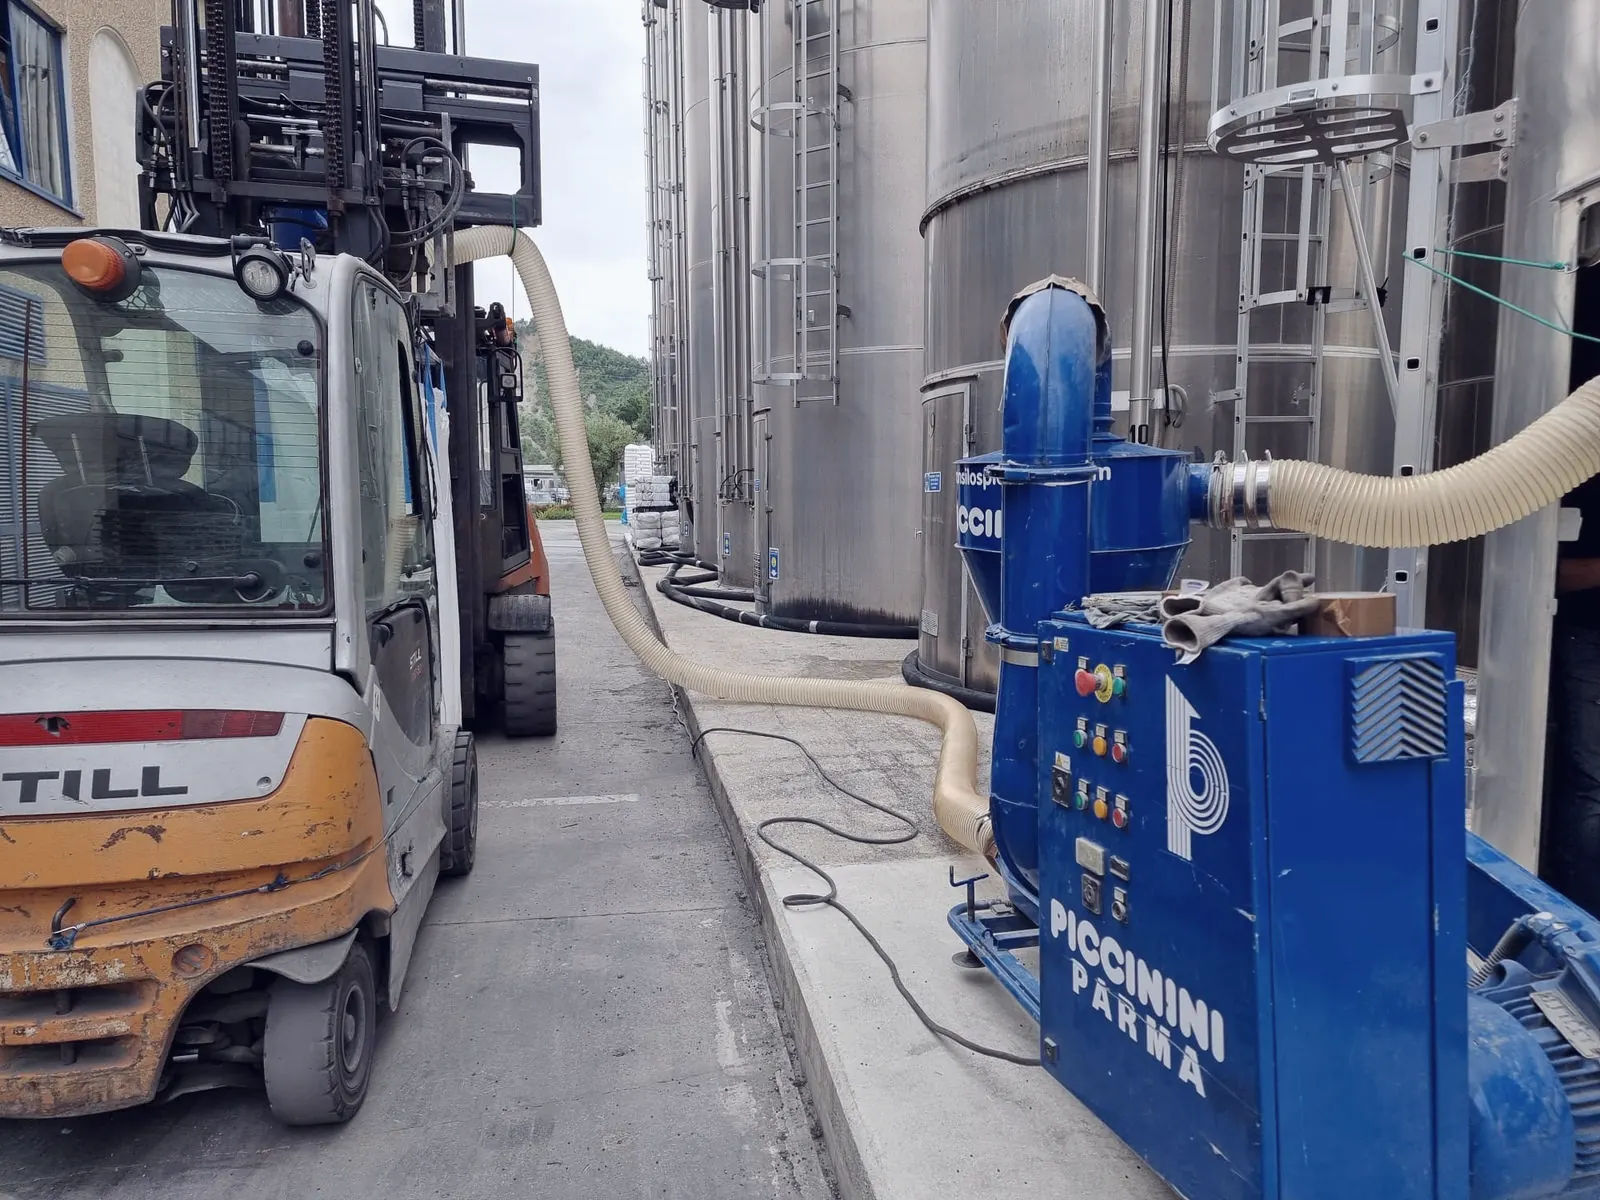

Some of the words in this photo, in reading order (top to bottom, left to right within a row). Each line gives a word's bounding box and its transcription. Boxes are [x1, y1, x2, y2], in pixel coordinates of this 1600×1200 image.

[1129, 424, 1149, 445] 10
[2, 766, 188, 803] TILL
[1050, 898, 1225, 1063] PICCININI
[1071, 959, 1206, 1098] PARMA
